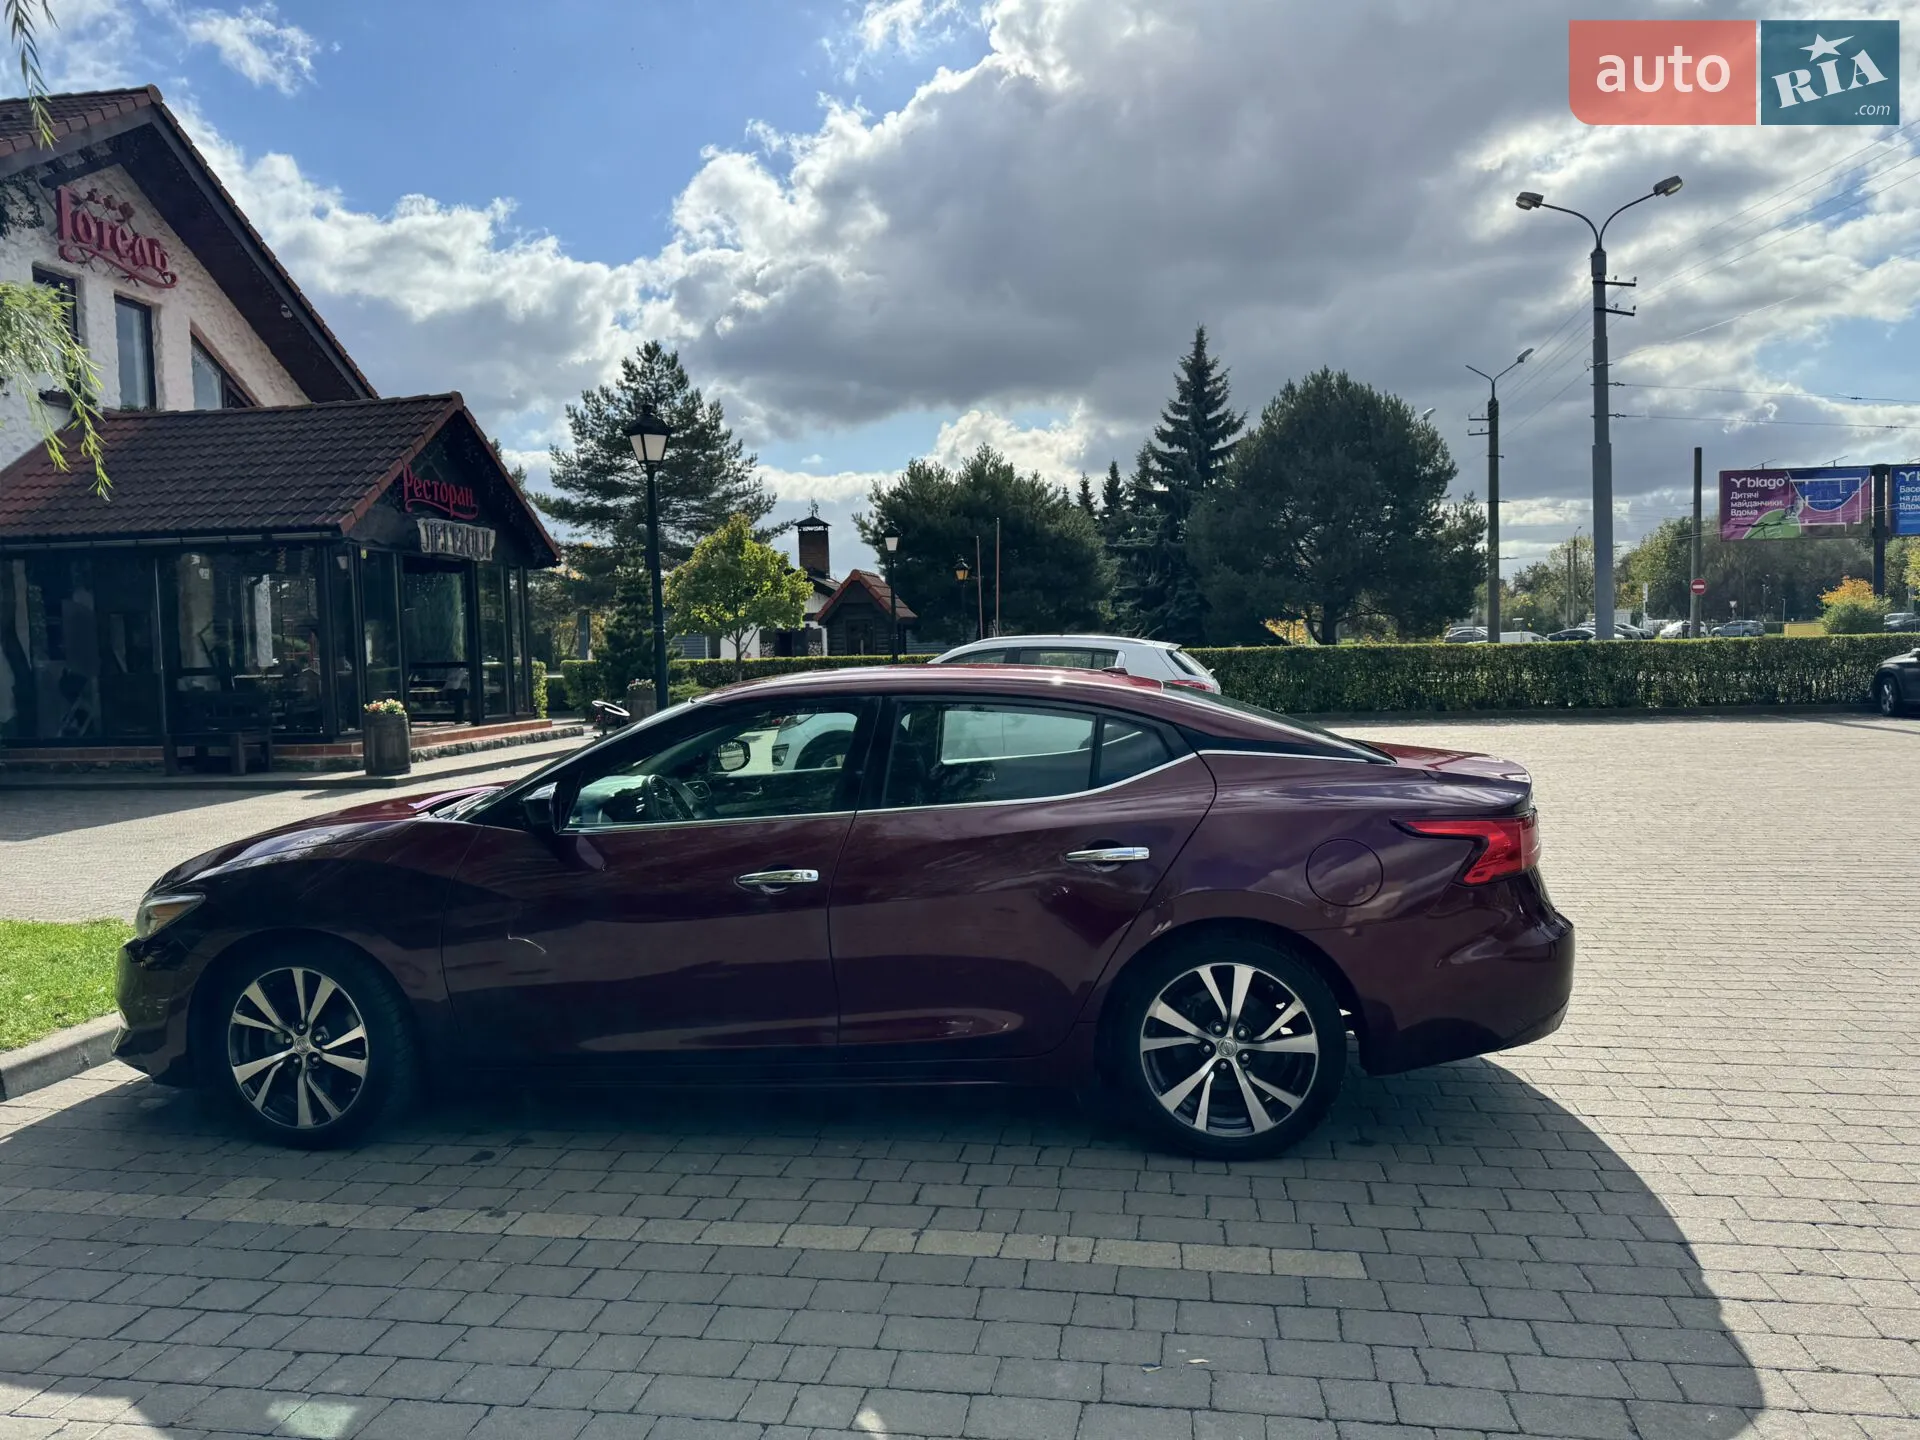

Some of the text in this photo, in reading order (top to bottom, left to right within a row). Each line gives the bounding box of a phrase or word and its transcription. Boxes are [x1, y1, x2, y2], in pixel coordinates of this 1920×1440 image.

[1747, 477, 1785, 490] blago
[403, 464, 476, 518] Ресторан
[1730, 491, 1759, 500] Дитячі
[1730, 500, 1785, 508] майданчики.
[1730, 508, 1758, 517] Вдома
